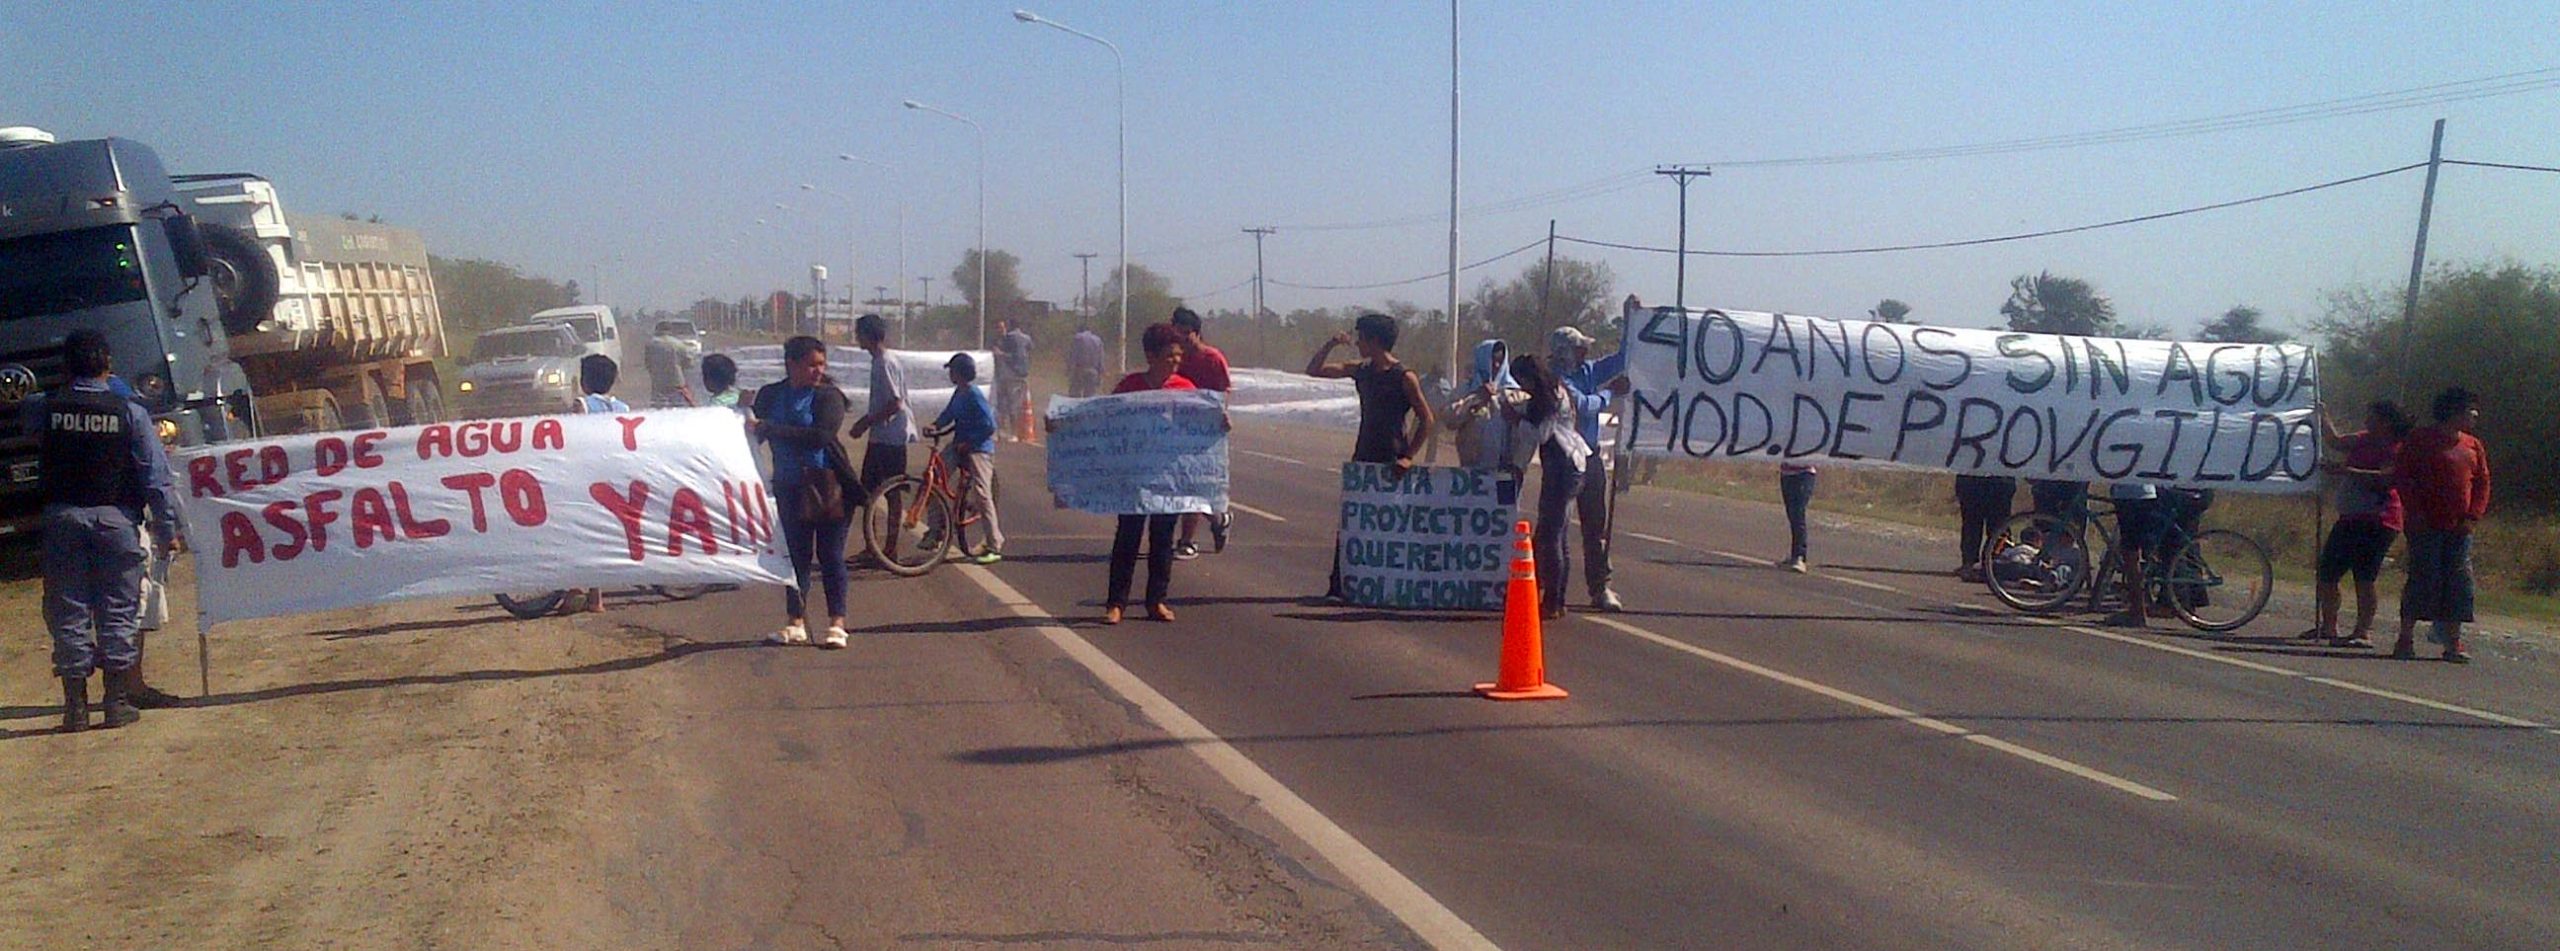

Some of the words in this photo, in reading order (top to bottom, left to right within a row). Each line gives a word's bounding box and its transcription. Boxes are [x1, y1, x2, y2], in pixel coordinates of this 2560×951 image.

[1637, 306, 1745, 385] 40
[1751, 313, 1972, 391] ANOS
[1995, 334, 2130, 400] SIN
[2157, 340, 2319, 408] AGUA
[51, 412, 120, 433] POLICIA
[188, 445, 290, 498] RED
[315, 431, 387, 477] DE
[417, 419, 564, 460] AGUA
[616, 416, 645, 451] Y
[1342, 462, 1434, 495] BASTA
[1450, 467, 1490, 497] DE
[220, 468, 547, 568] ASFALTO
[589, 479, 775, 562] YA!!!
[1341, 501, 1509, 537] PROYECTOS
[1346, 536, 1501, 572] QUEREMOS
